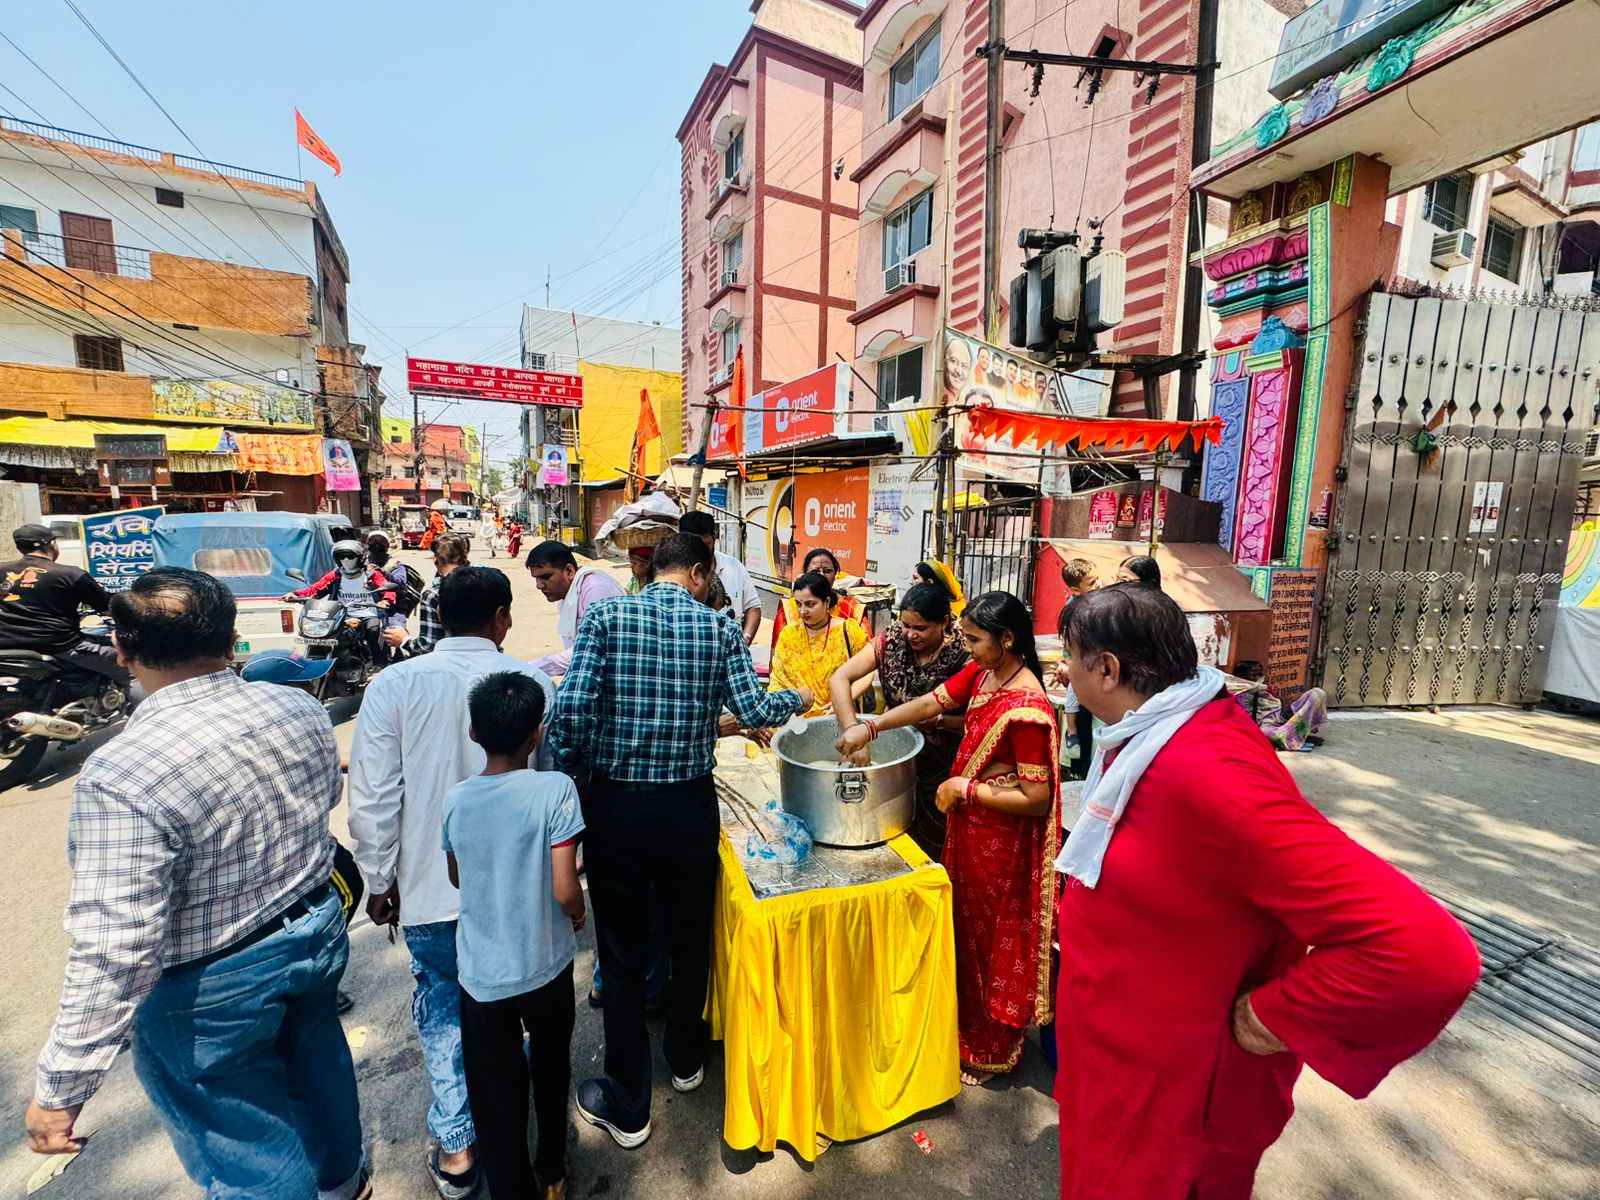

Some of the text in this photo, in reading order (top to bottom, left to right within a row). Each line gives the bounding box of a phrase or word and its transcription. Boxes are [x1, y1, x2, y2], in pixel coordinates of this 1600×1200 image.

[454, 364, 474, 375] मंदिर
[513, 372, 538, 381] आपका
[543, 375, 566, 384] स्वागत
[791, 390, 818, 410] orient
[823, 498, 857, 519] orient
[86, 515, 154, 540] रवि
[823, 521, 848, 532] electric
